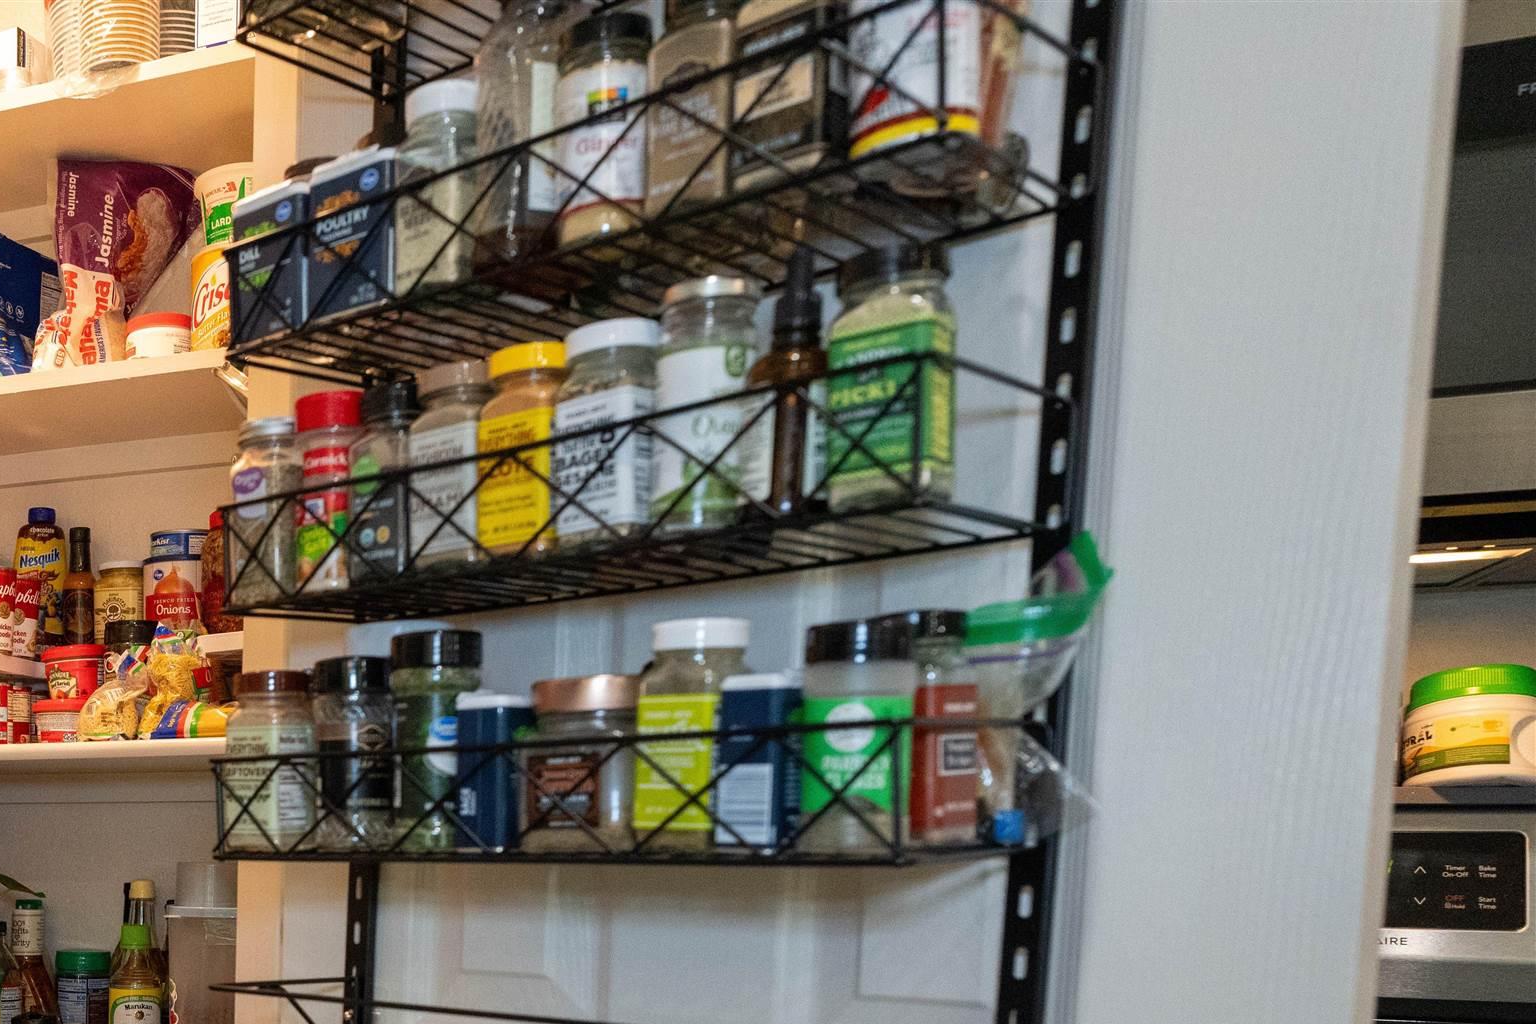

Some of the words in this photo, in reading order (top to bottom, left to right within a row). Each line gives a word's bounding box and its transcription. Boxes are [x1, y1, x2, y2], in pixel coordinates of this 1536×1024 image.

[67, 171, 80, 218] Jasmine
[95, 193, 115, 268] Jasmine
[211, 215, 232, 230] LARD
[239, 245, 261, 265] DILL
[19, 549, 60, 569] Nesquik
[155, 604, 192, 616] Onions
[124, 1003, 154, 1011] Marukan
